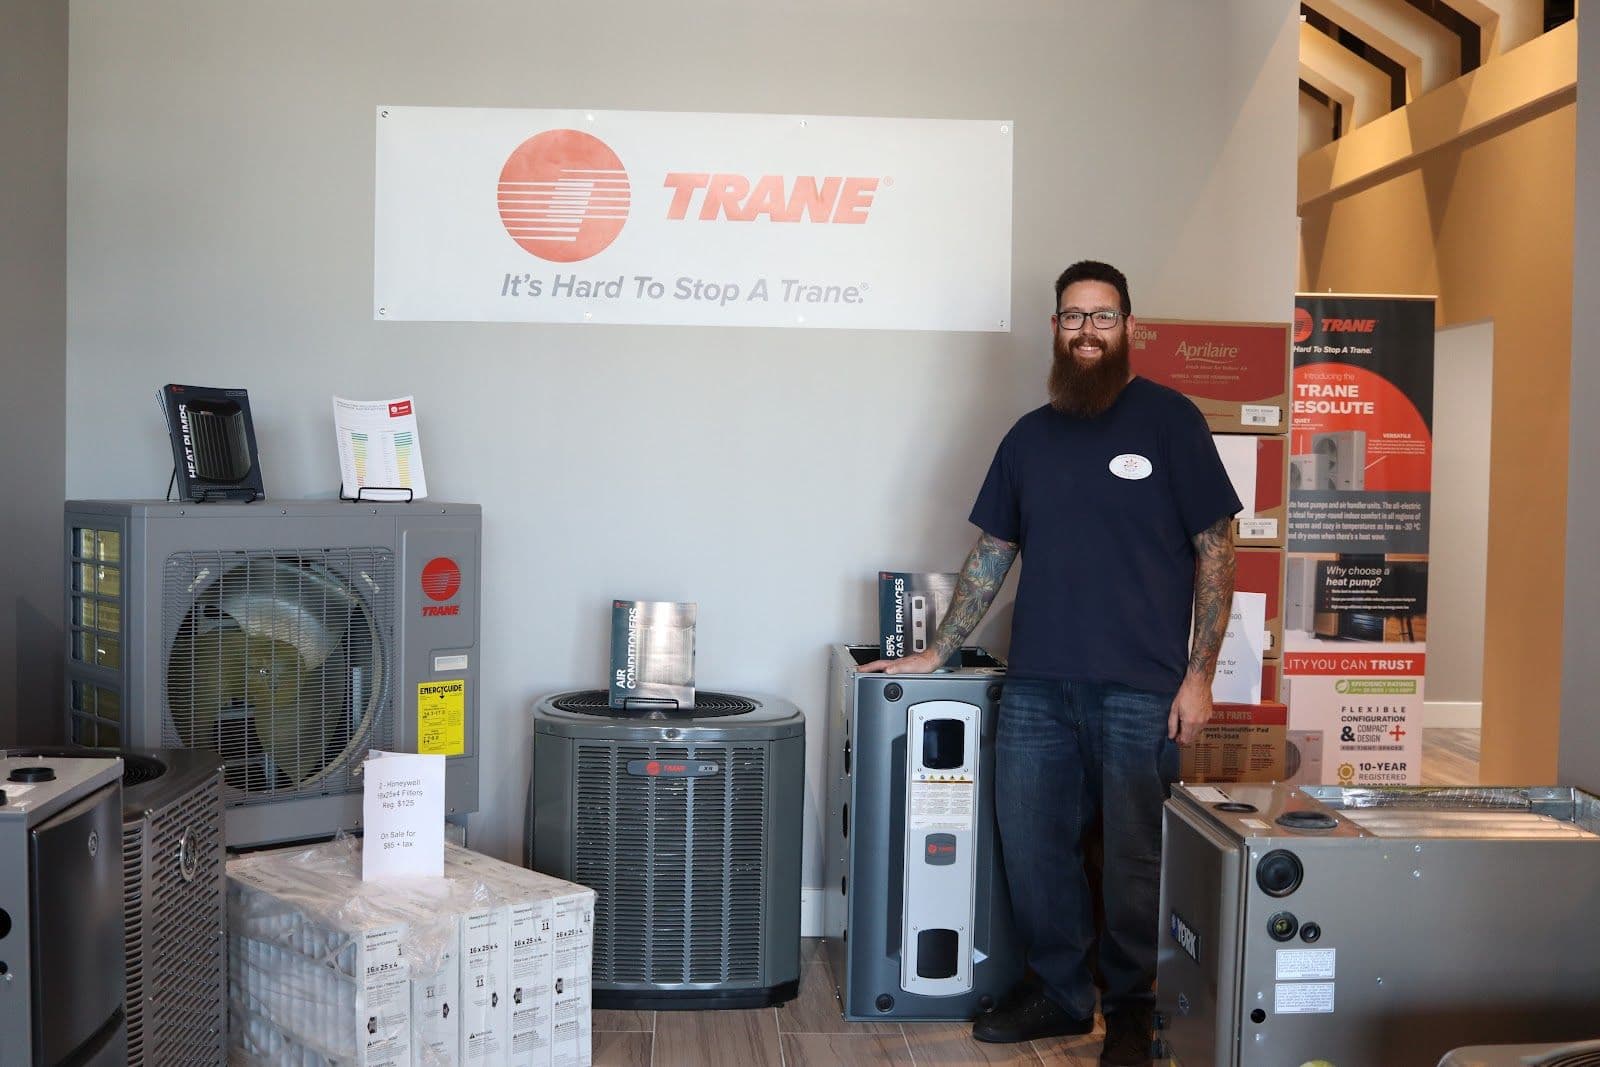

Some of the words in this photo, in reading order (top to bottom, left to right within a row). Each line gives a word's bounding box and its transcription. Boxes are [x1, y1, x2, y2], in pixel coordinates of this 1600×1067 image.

[663, 172, 880, 225] TRANE
[500, 273, 543, 297] It's
[551, 274, 624, 299] Hard
[633, 275, 665, 299] To
[672, 276, 740, 306] Stop
[746, 278, 769, 301] A
[1321, 318, 1377, 333] TRANE
[1174, 340, 1238, 361] Aprilaire
[1293, 345, 1312, 353] Hard
[1323, 346, 1341, 355] Stop
[1342, 346, 1349, 354] A
[1343, 372, 1355, 380] the
[1296, 384, 1359, 398] TRANE
[1291, 400, 1374, 414] ESOLUTE
[1326, 566, 1346, 578] Why
[1348, 566, 1382, 576] choose
[1326, 577, 1348, 587] heat
[1349, 577, 1383, 587] pump?
[422, 605, 460, 617] TRANE
[626, 608, 640, 690] CONDITIONERS
[885, 634, 895, 656] 95%
[1310, 659, 1336, 670] YOU
[1340, 659, 1367, 670] CAN
[1369, 659, 1414, 671] TRUST
[615, 668, 626, 689] AIR
[1340, 725, 1356, 742] &
[1357, 724, 1388, 733] COMPACT
[1357, 734, 1381, 743] DESIGN
[1359, 762, 1407, 771] 10-YEAR
[1358, 773, 1407, 781] REGISTERED
